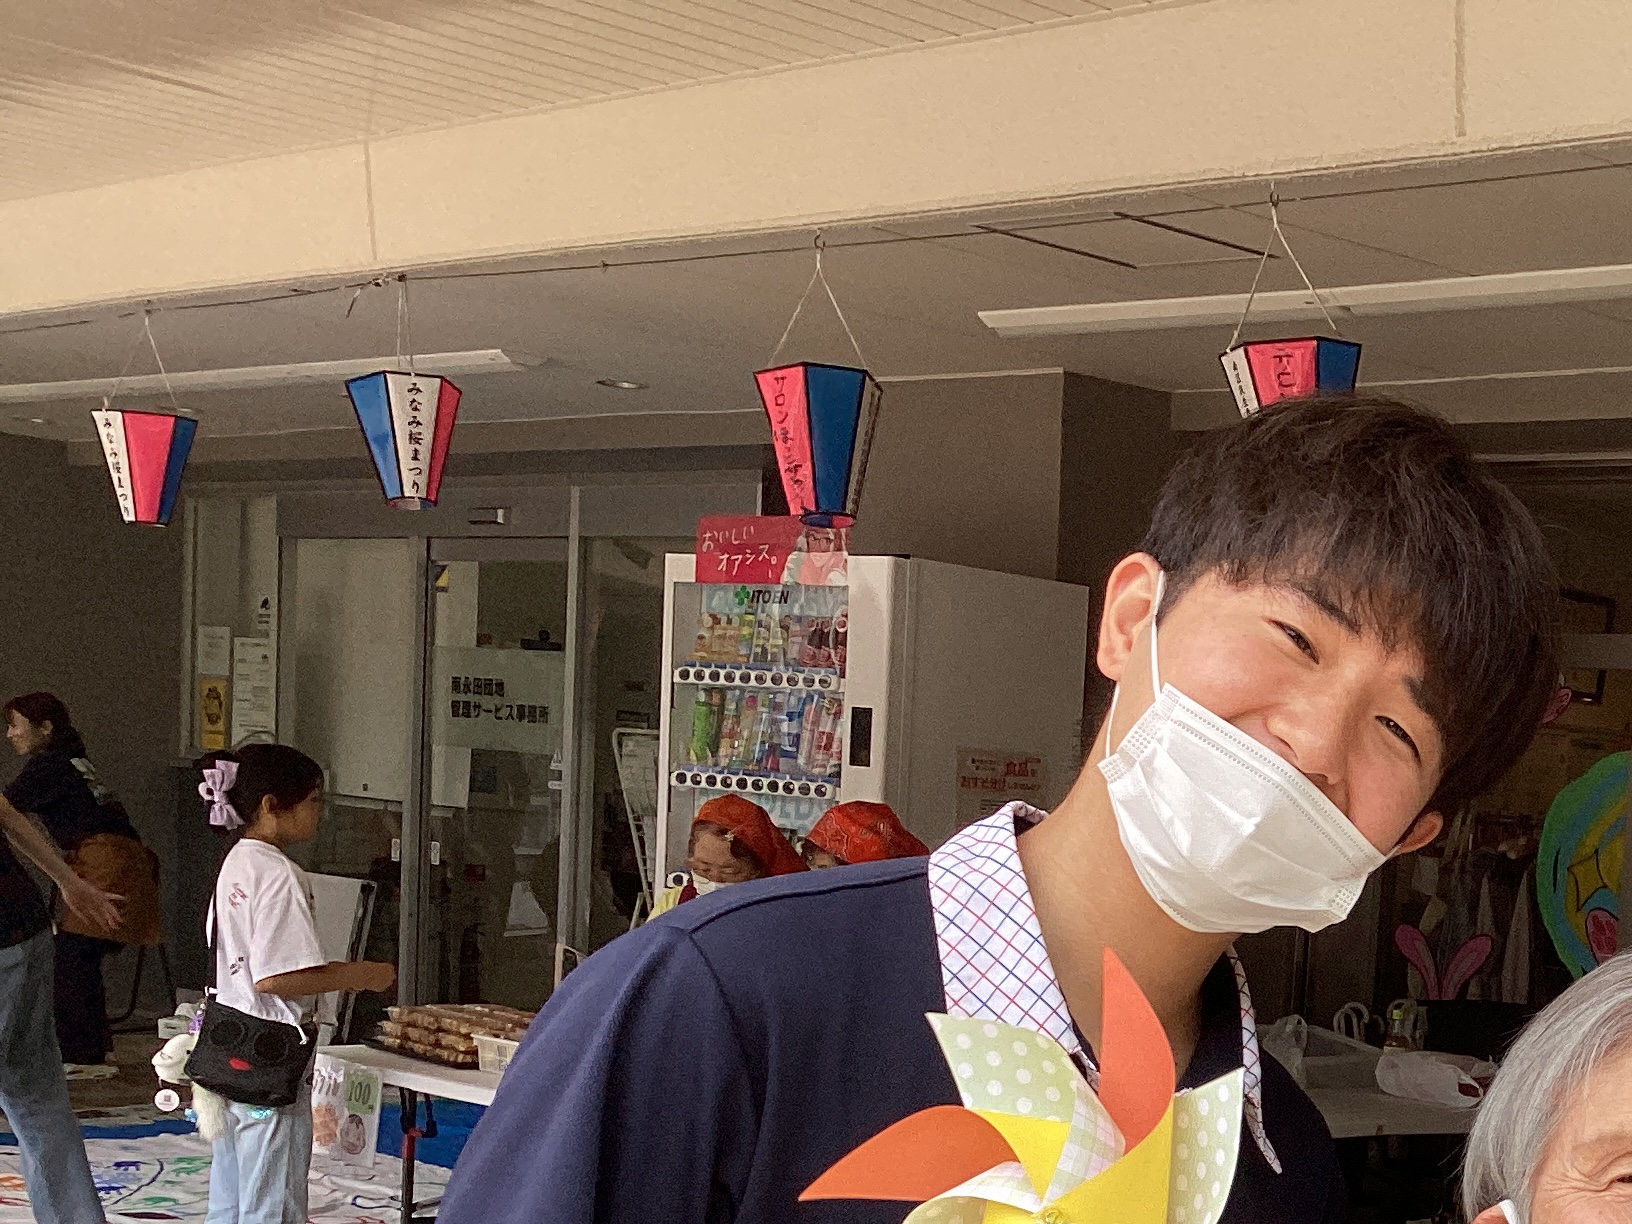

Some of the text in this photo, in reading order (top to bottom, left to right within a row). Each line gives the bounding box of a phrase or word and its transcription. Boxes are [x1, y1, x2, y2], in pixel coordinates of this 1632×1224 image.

[407, 382, 423, 494] みなみ桜まつり
[702, 525, 755, 553] おいしい
[750, 589, 772, 605] ITO
